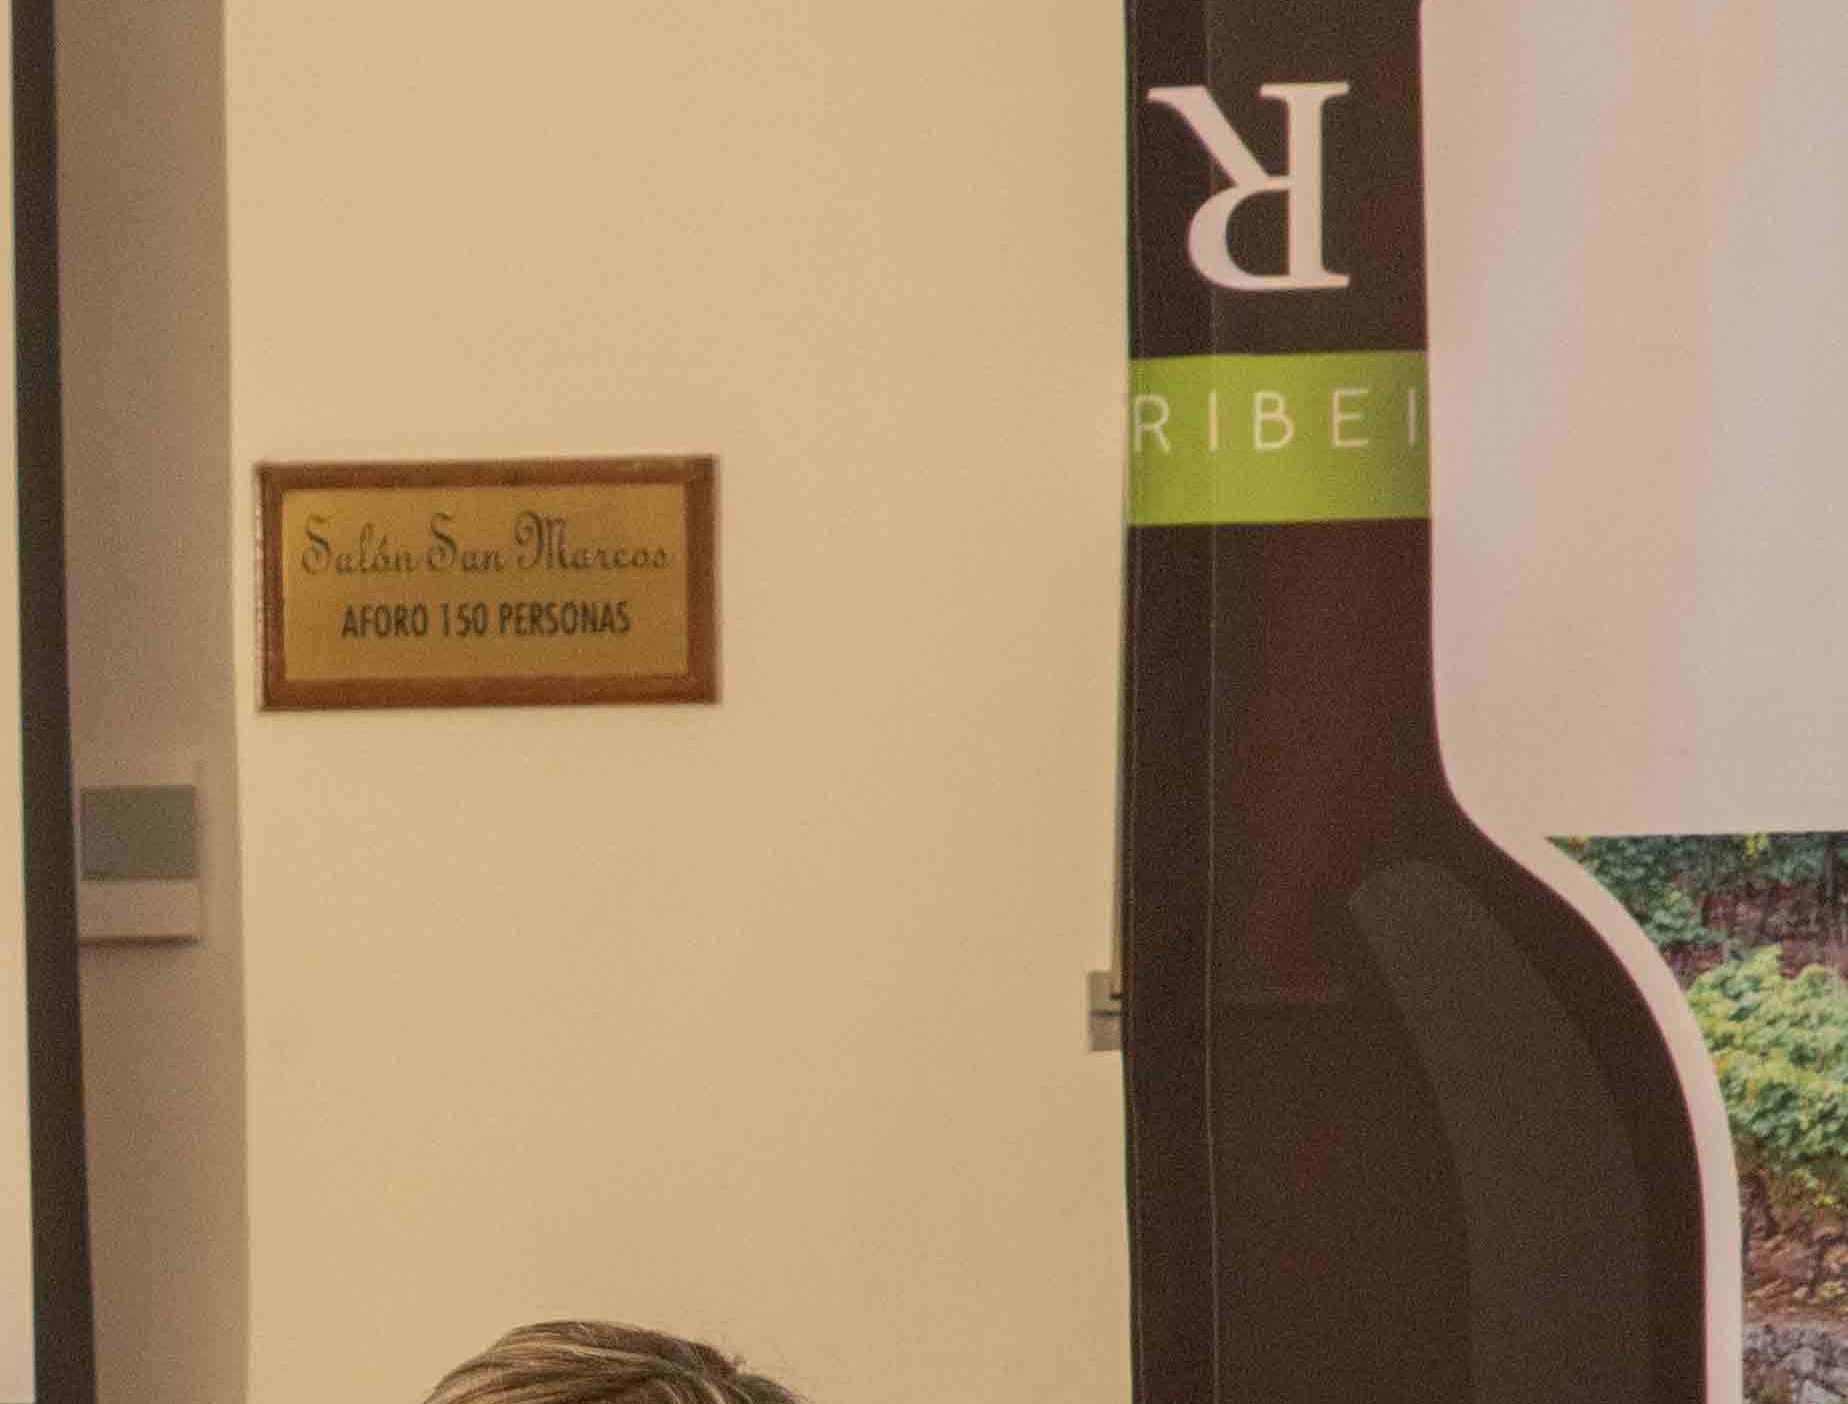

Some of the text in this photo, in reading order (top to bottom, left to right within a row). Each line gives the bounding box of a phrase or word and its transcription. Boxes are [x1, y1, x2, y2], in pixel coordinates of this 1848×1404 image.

[1148, 81, 1350, 291] R
[1134, 388, 1417, 453] RIBEI
[302, 510, 671, 576] Salón San Marcos
[341, 600, 632, 638] AFORO 150 PERSONAS
